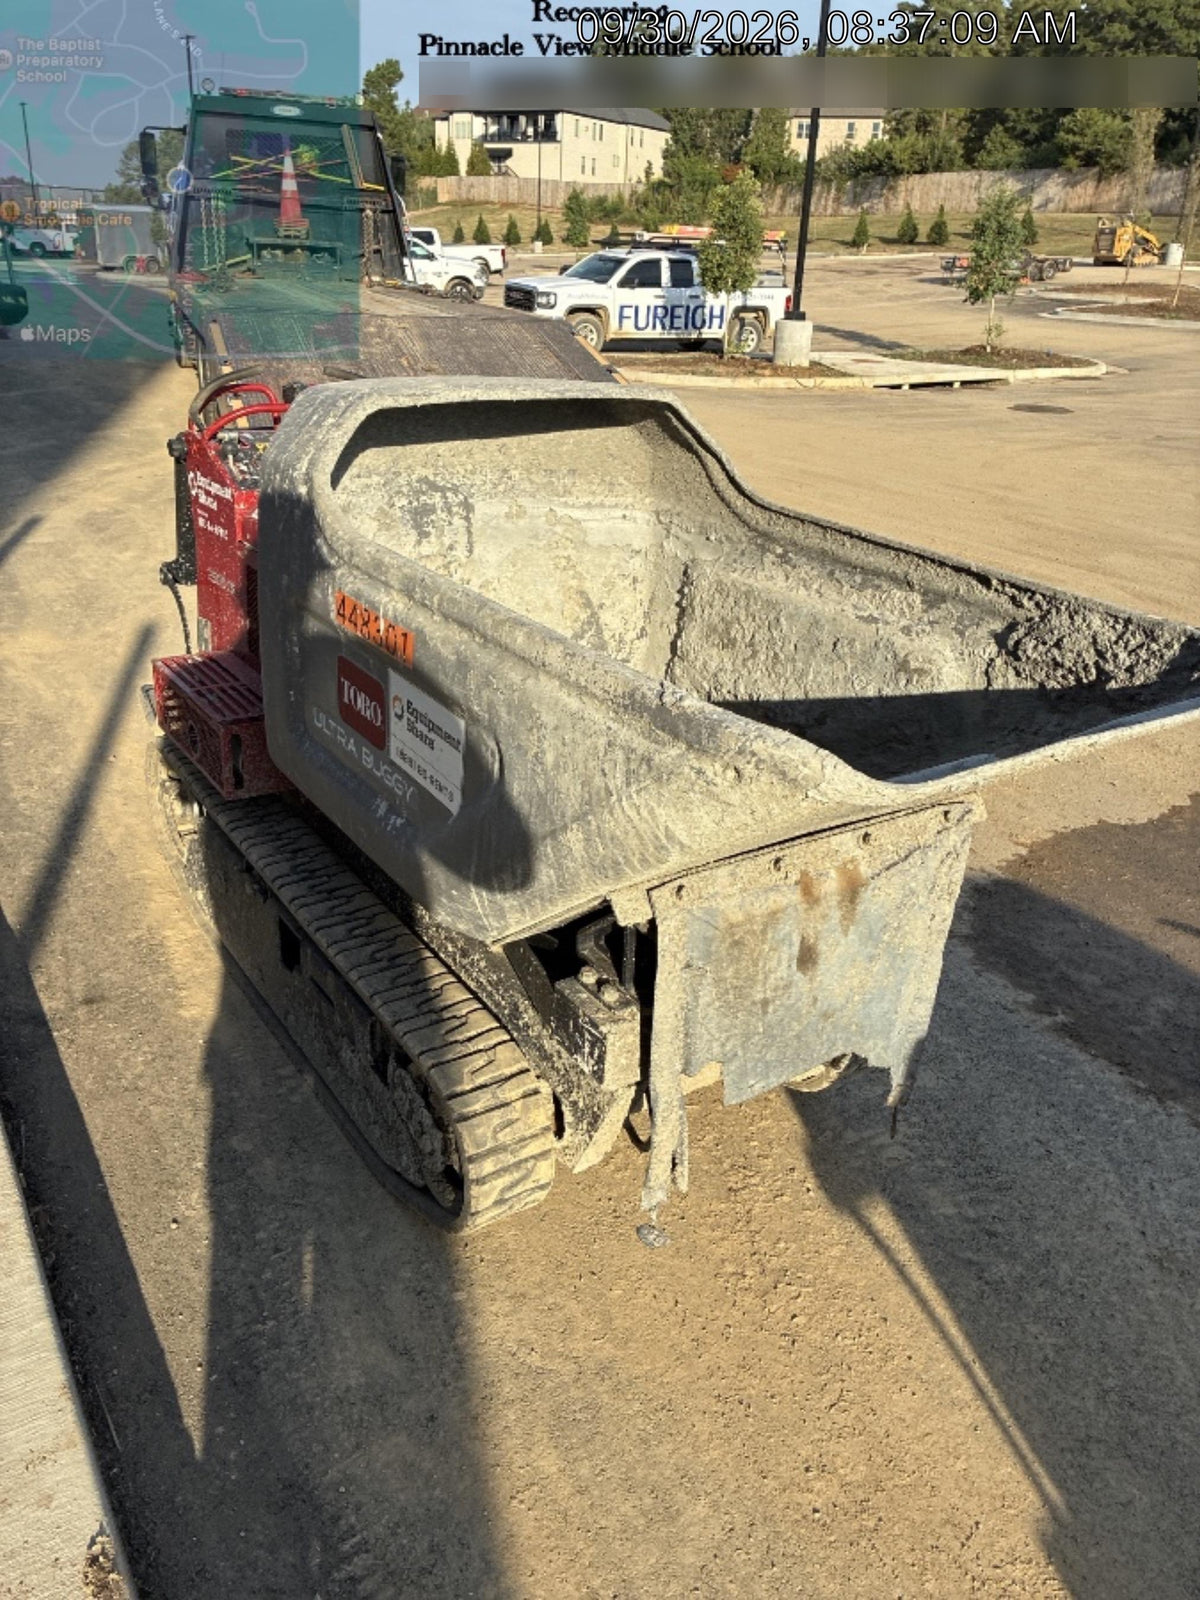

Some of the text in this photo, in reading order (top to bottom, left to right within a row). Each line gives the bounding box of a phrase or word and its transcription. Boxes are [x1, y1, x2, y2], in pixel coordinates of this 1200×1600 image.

[618, 304, 726, 331] FUREIGH
[341, 677, 383, 727] TORO
[406, 699, 462, 754] Equipment
[312, 706, 358, 759] ULTRA
[406, 716, 436, 752] Share
